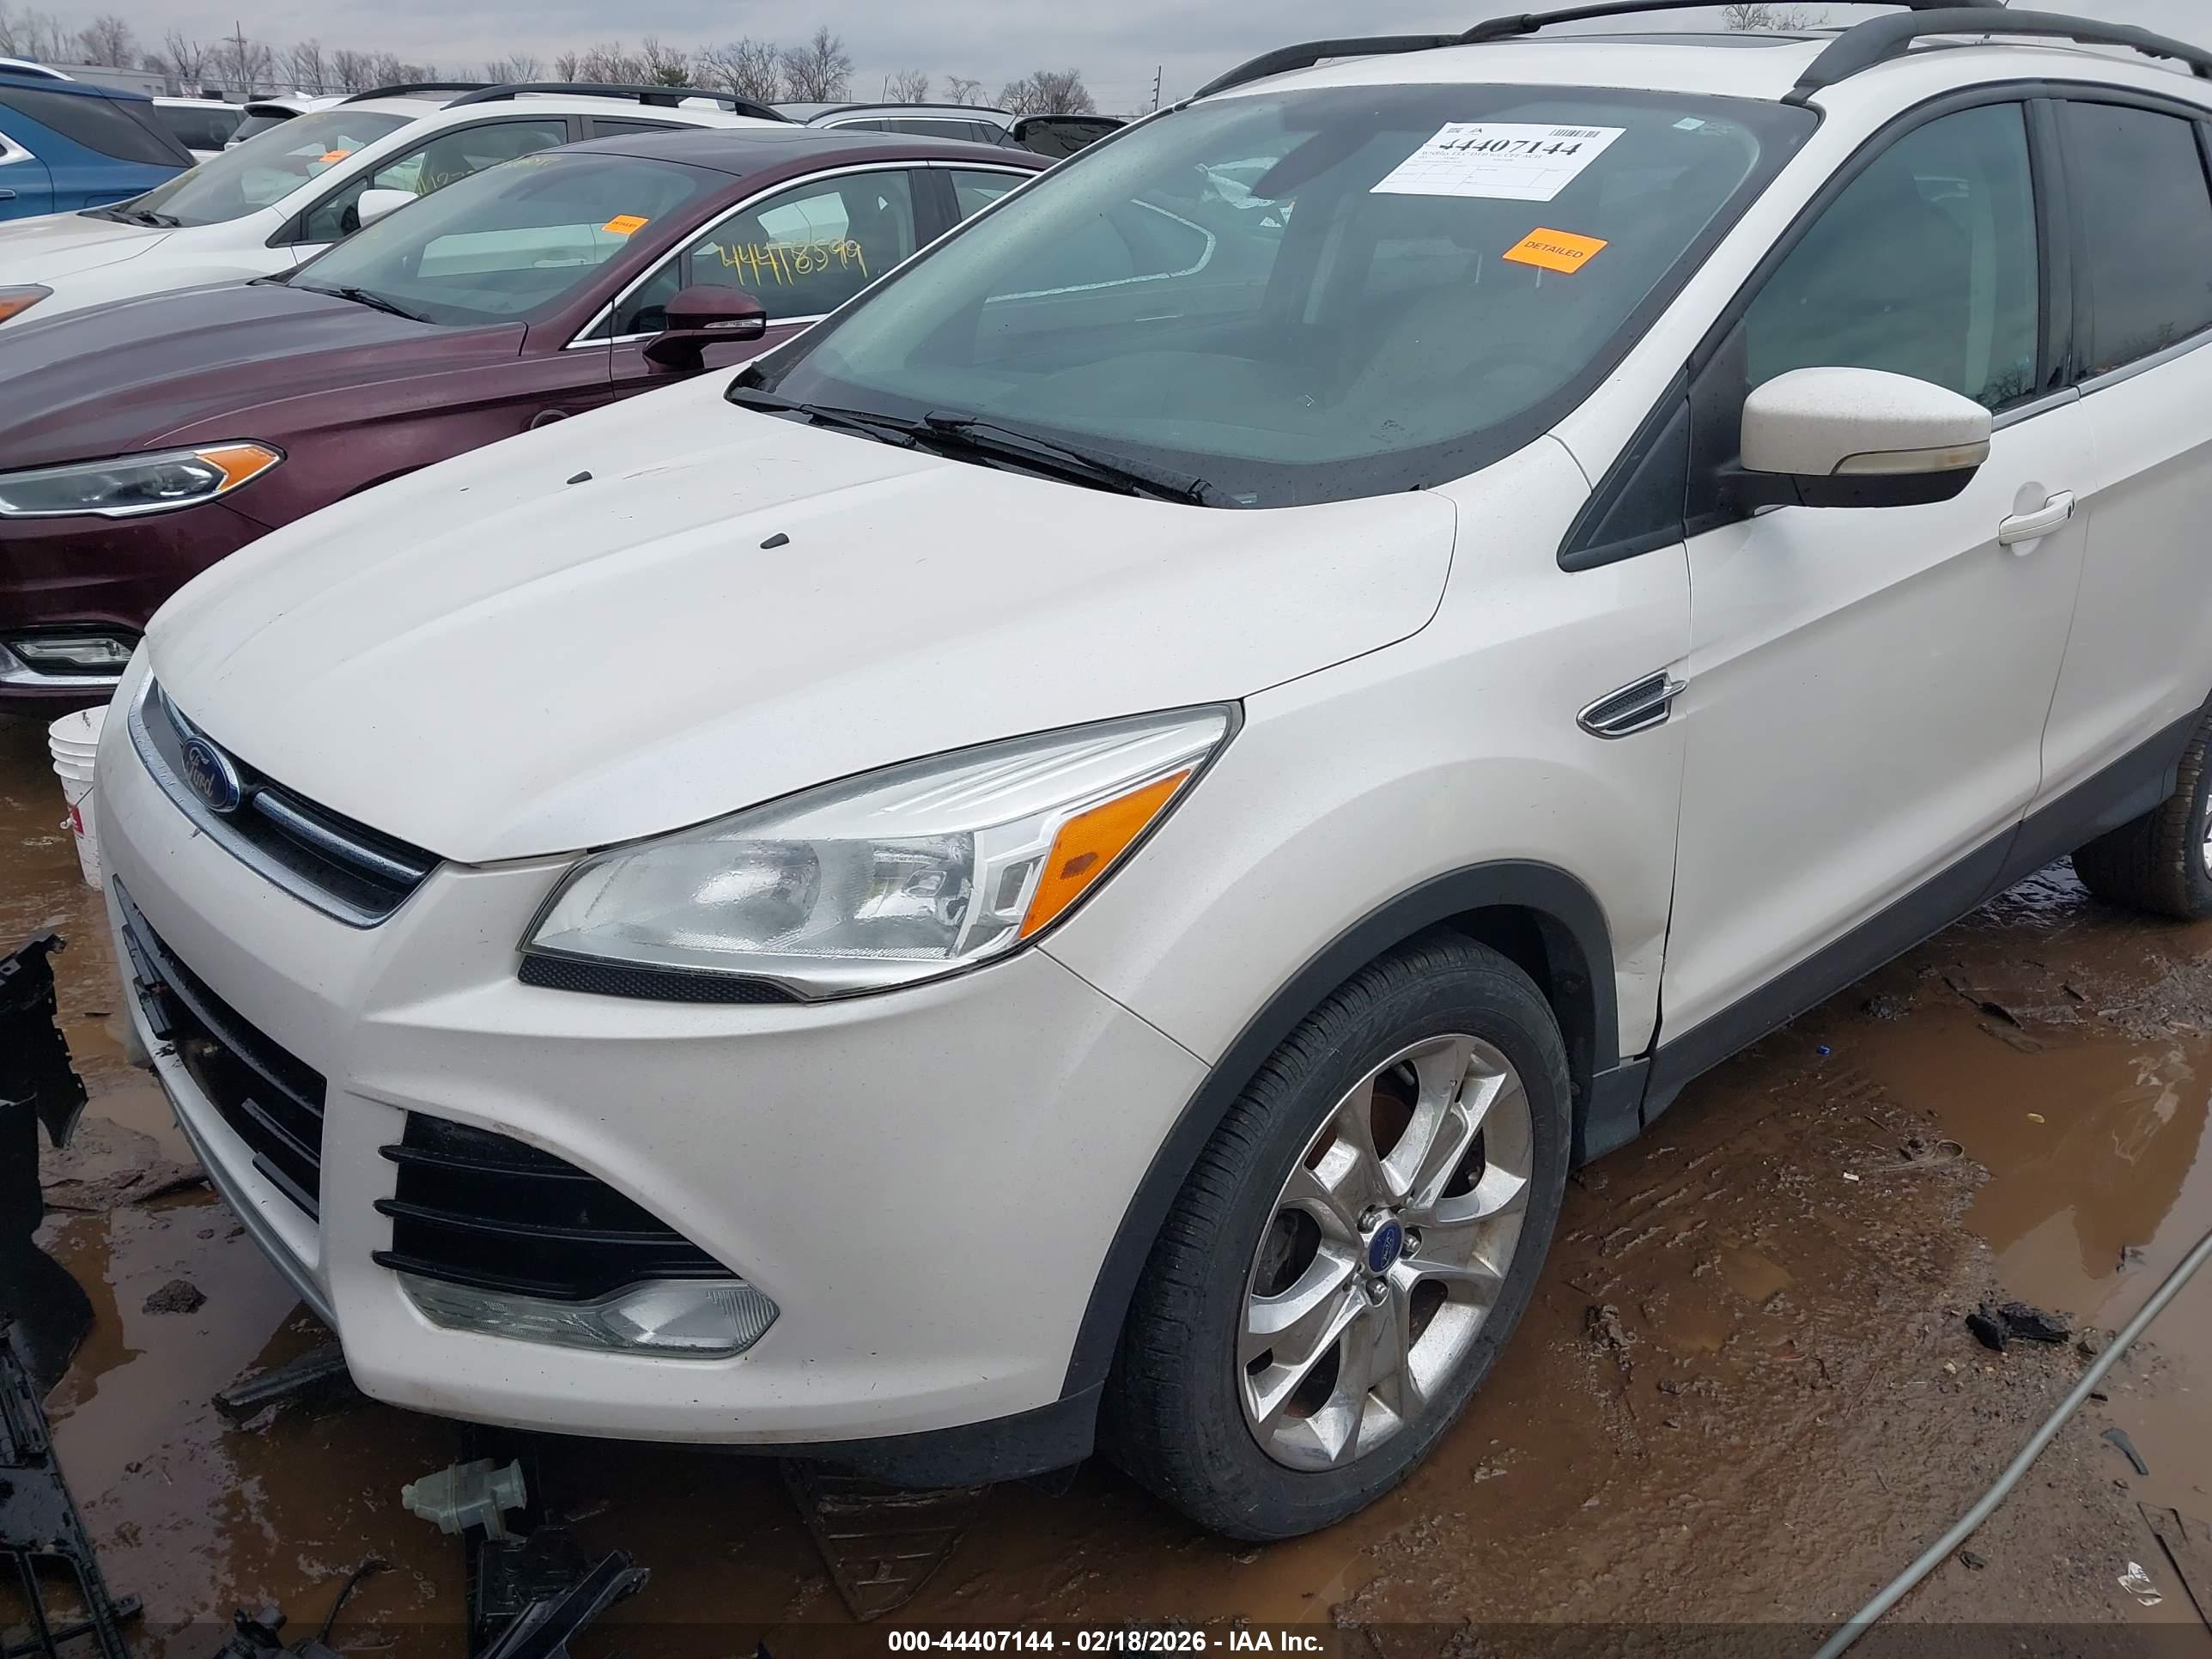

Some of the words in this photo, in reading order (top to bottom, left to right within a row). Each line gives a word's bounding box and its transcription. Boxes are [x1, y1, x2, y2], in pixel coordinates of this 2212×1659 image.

[1438, 138, 1583, 156] 44407144
[1523, 240, 1584, 259] DETAILED
[185, 745, 215, 798] Ford
